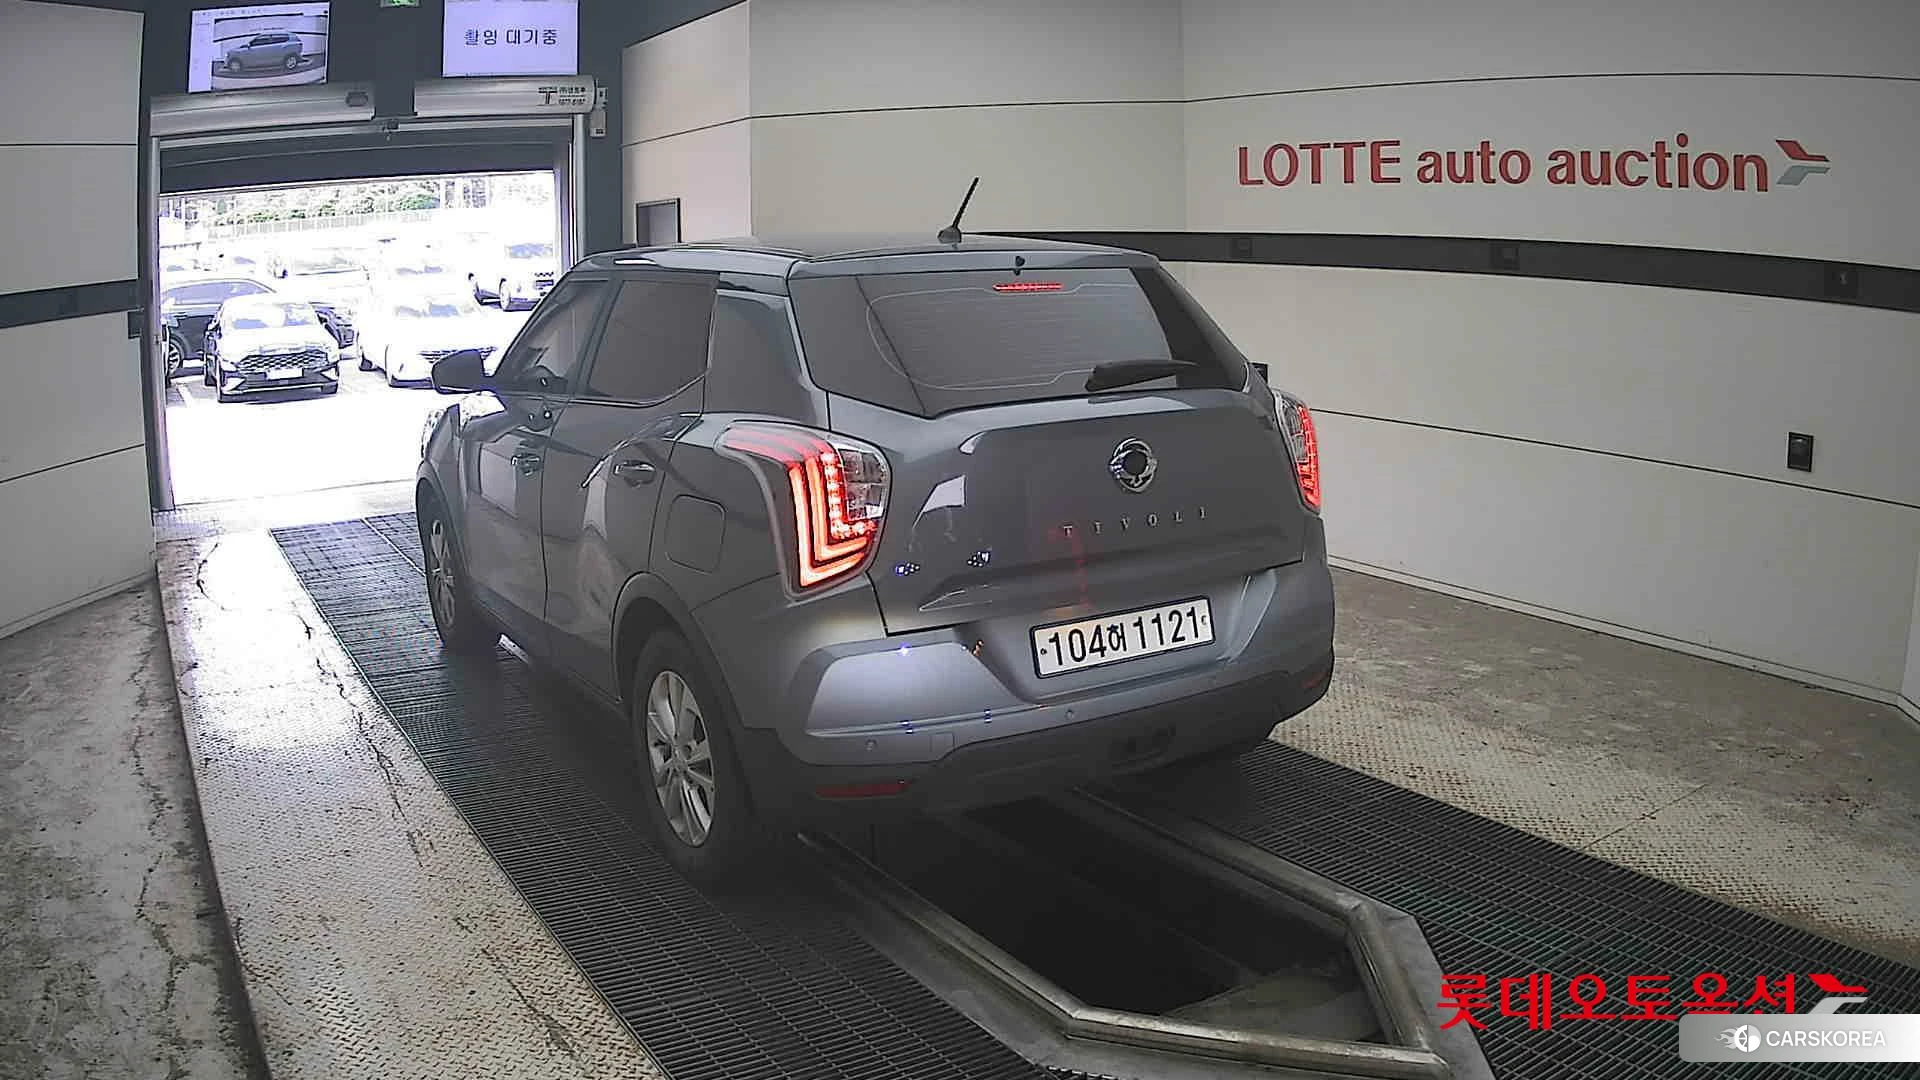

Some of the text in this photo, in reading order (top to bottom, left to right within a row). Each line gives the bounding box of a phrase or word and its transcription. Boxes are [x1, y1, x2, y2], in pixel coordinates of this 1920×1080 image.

[506, 29, 558, 46] 대기중
[1238, 133, 1768, 192] LOTTE auto auction
[1063, 506, 1207, 537] TIVOLI
